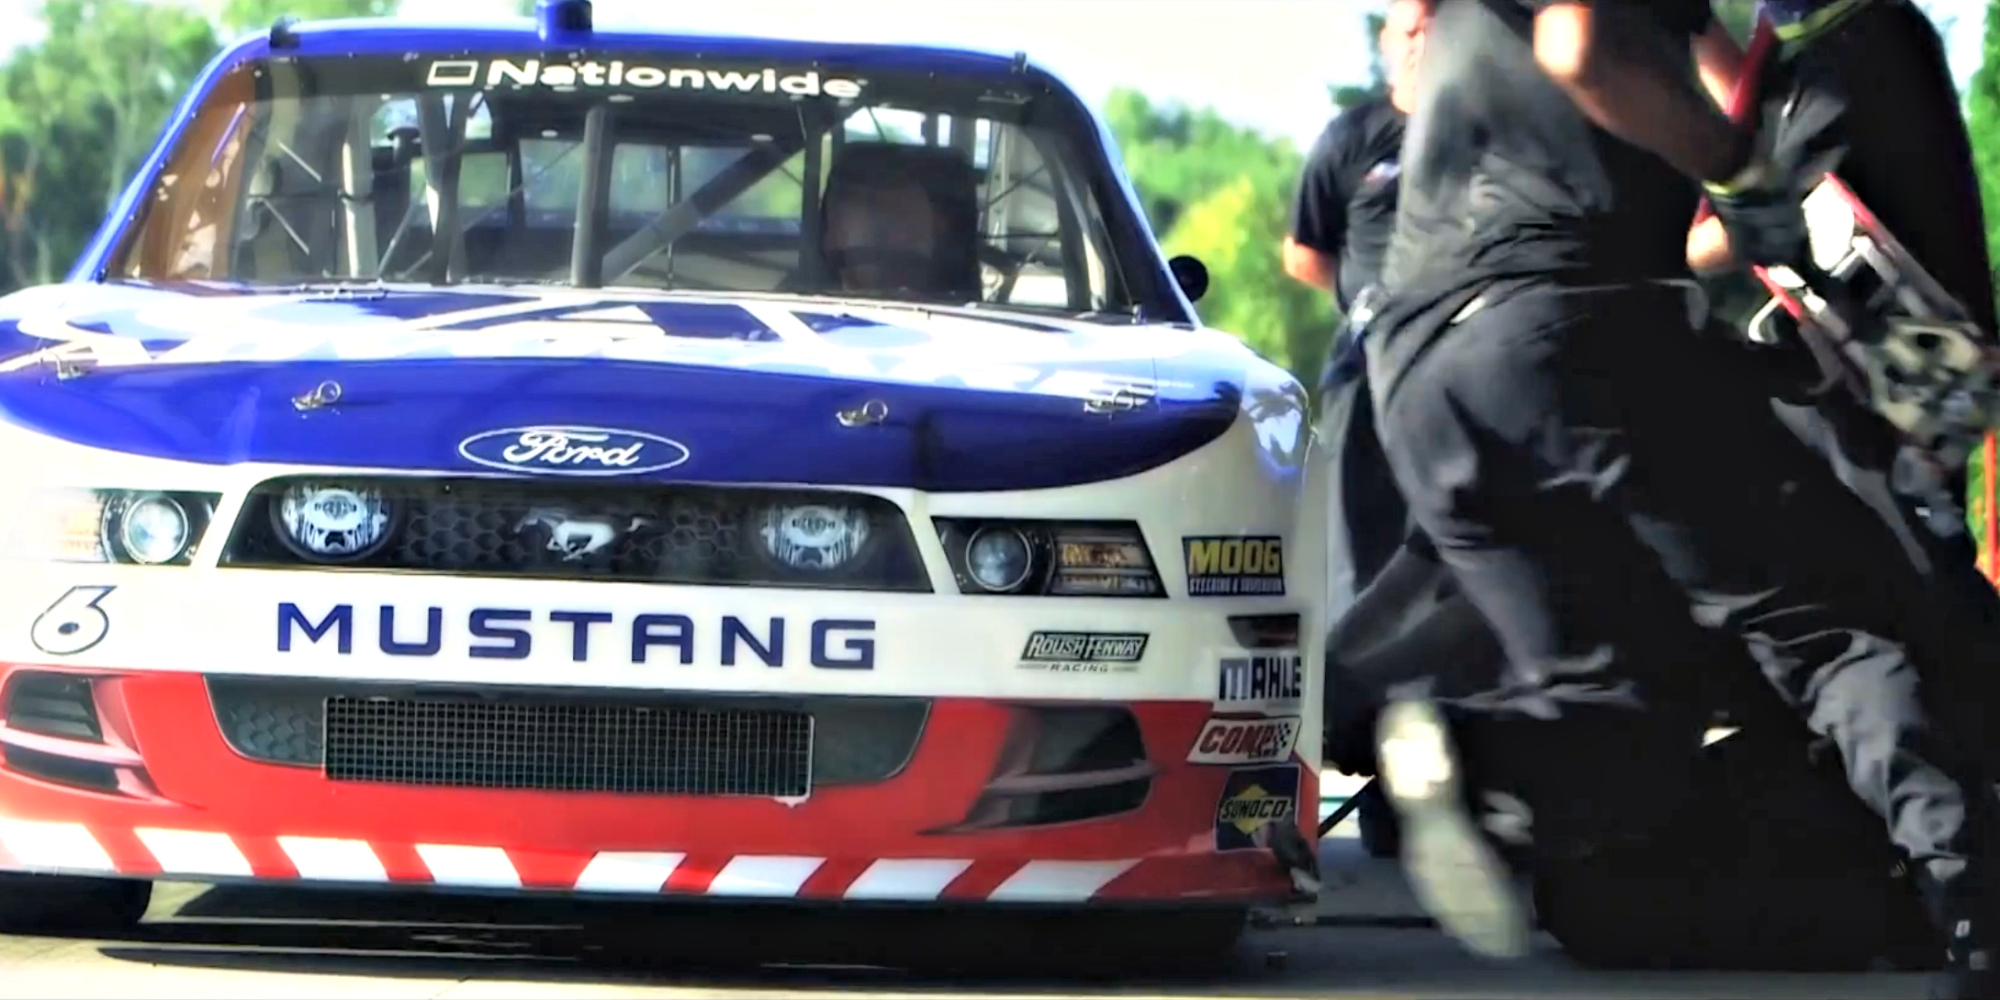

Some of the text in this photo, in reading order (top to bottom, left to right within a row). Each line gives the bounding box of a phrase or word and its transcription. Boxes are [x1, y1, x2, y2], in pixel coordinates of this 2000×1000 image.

[487, 59, 861, 99] Nationwide
[503, 430, 644, 466] Ford
[1189, 540, 1280, 575] MOOG
[30, 585, 117, 656] 6
[277, 602, 875, 670] MUSTANG
[1027, 633, 1144, 659] ROUSH FENWAY
[1050, 663, 1108, 673] RACING
[1219, 656, 1301, 700] MAHLE
[1220, 799, 1290, 819] SUNOCO
